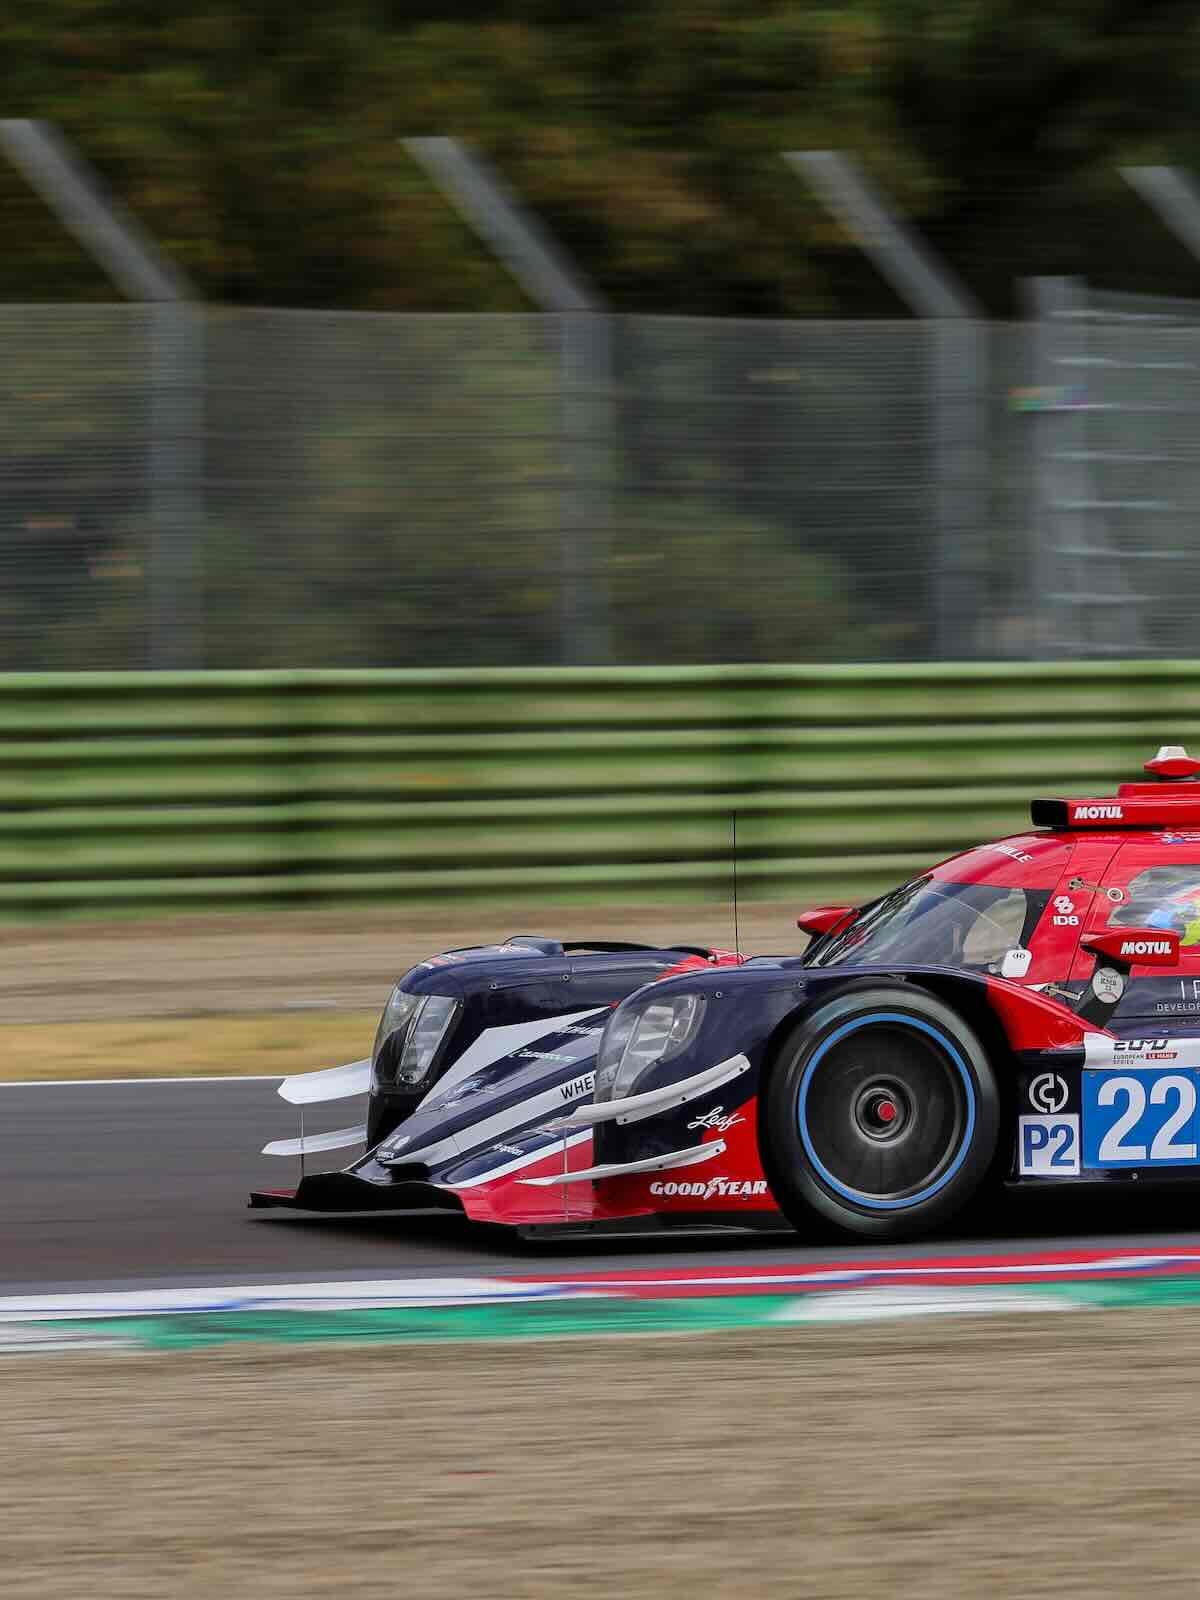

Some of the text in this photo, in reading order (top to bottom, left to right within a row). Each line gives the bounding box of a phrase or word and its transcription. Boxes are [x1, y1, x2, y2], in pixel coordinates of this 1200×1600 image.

[1074, 806, 1123, 819] MOTUL
[1120, 941, 1172, 955] MOTUL
[1098, 1075, 1197, 1160] 22
[1024, 1124, 1075, 1167] P2
[649, 1177, 768, 1200] GOODYEAR
